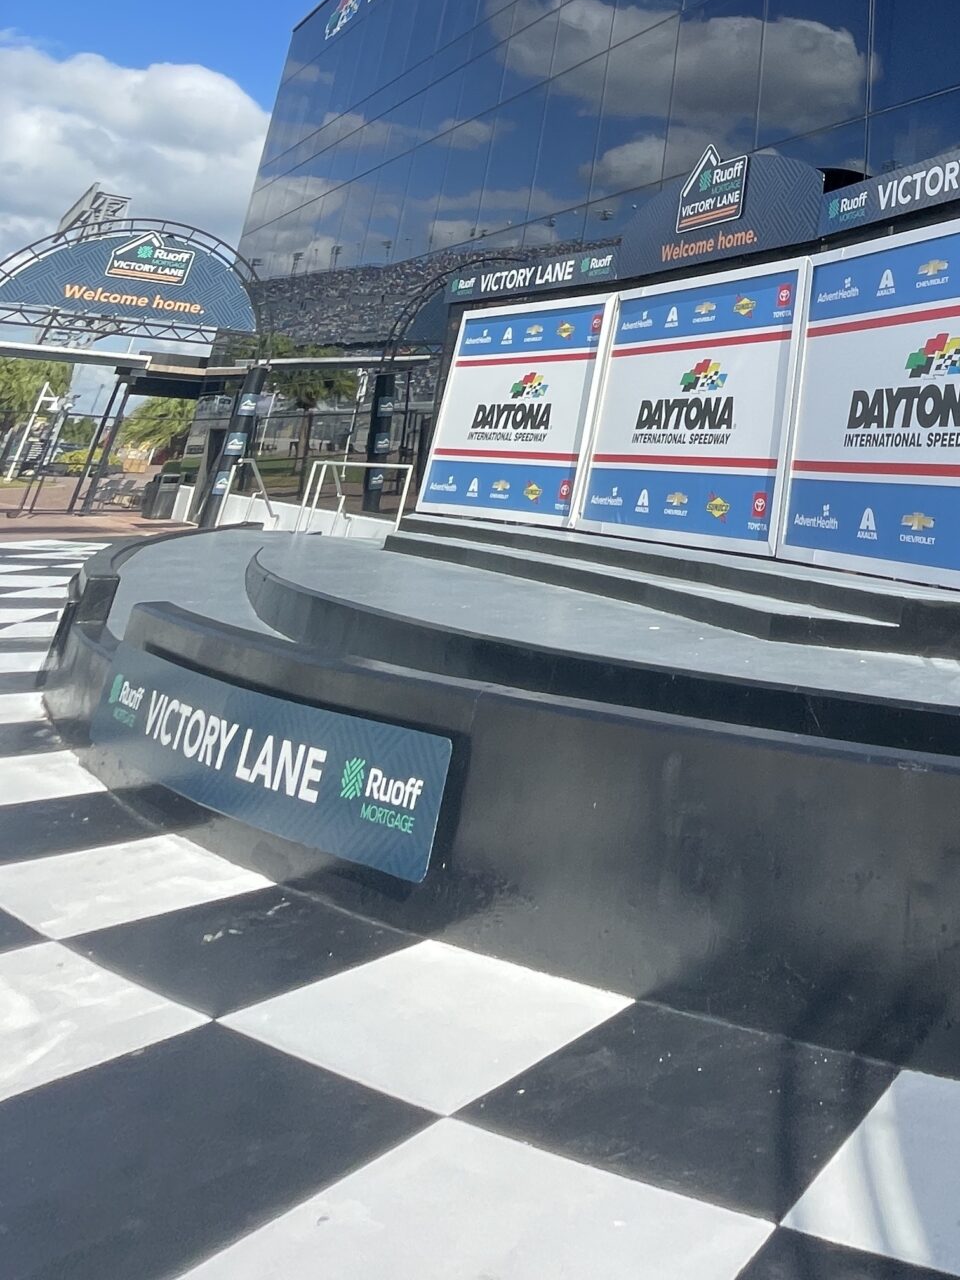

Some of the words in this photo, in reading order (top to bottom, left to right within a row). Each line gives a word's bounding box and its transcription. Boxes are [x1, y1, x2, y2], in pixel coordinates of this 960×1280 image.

[712, 161, 744, 184] Ruoff
[682, 196, 717, 218] VICTORY
[716, 191, 740, 207] LANE
[840, 191, 868, 212] Ruoff
[661, 240, 714, 263] Welcome
[717, 229, 758, 250] home.
[153, 248, 191, 263] Ruoff
[590, 254, 614, 269] Ruoff
[113, 259, 157, 273] VICTORY
[157, 266, 185, 277] LANE
[480, 266, 535, 293] VICTORY
[535, 259, 575, 285] LANE
[458, 277, 477, 289] Ruoff
[916, 276, 949, 289] CHEVROLET
[63, 284, 149, 307] Welcome
[152, 295, 205, 315] home.
[817, 286, 859, 304] AdventHealth
[876, 287, 896, 297] AXALTA
[773, 309, 792, 318] TOYOTA
[471, 402, 551, 430] DAYTONA
[635, 396, 734, 430] DAYTONA
[467, 431, 513, 442] INTERNATIONAL
[514, 432, 548, 443] SPEEDWAY
[631, 432, 687, 445] INTERNATIONAL
[688, 432, 732, 445] SPEEDWAY
[843, 432, 922, 448] INTERNATIONAL
[747, 521, 767, 532] TOYOTA
[794, 513, 838, 530] AdventHealth
[857, 531, 878, 541] AXALTA
[899, 534, 935, 545] CHEVROLET
[145, 690, 239, 770] VICTORY
[235, 728, 328, 804] LANE
[365, 767, 424, 810] Ruoff
[360, 803, 416, 835] MORTGAGE
